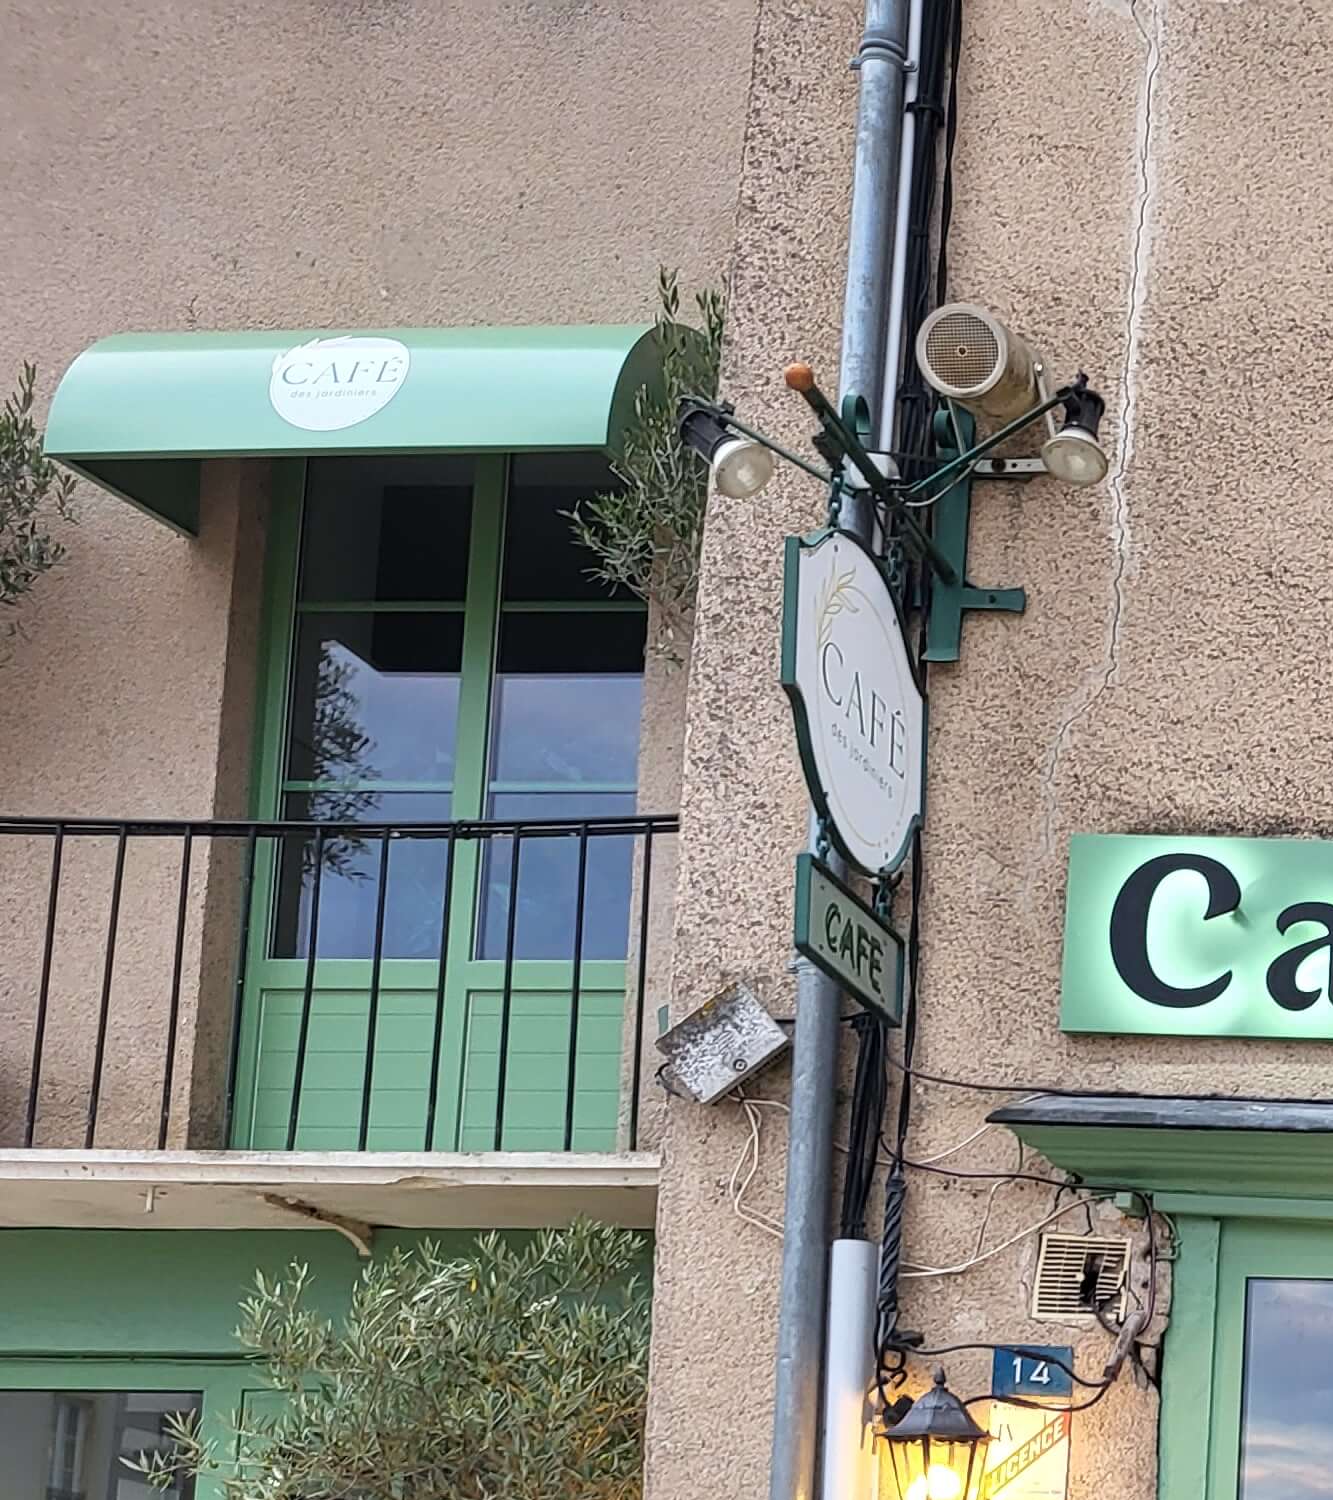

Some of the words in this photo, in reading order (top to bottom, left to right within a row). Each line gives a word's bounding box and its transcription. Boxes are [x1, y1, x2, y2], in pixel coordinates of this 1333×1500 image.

[282, 356, 403, 385] CAFÉ
[290, 389, 312, 399] des
[316, 388, 377, 399] jardiniers
[822, 641, 906, 779] CAFÉ
[825, 902, 884, 994] CAFE
[1012, 1357, 1051, 1385] 14
